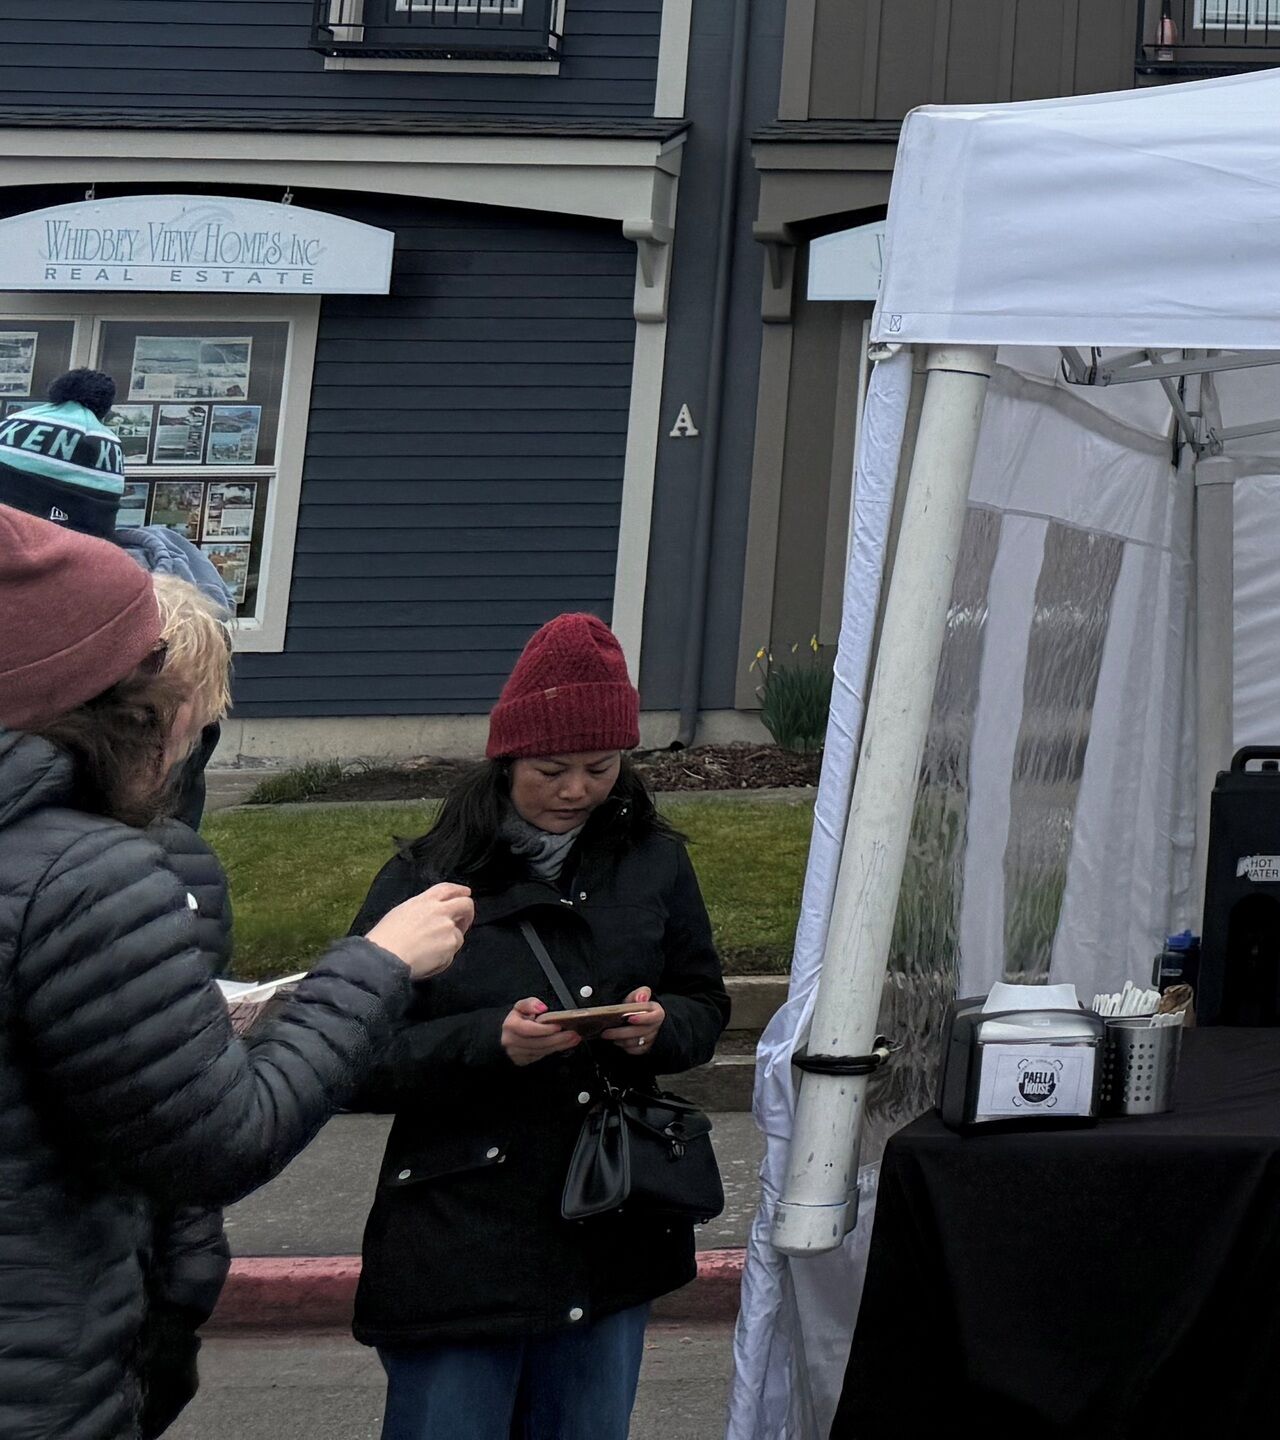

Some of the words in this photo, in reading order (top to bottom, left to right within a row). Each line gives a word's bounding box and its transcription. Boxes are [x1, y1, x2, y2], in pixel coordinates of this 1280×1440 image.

[45, 220, 140, 262] WHIDBEY
[148, 222, 200, 263] VIEW
[206, 223, 282, 265] HOMES
[288, 235, 320, 266] INC
[45, 268, 135, 281] REAL
[170, 270, 314, 286] ESTATE
[669, 403, 699, 437] A
[1250, 859, 1273, 868] HOT
[1022, 1071, 1055, 1084] PAELLA
[1023, 1082, 1051, 1095] HOUSE
